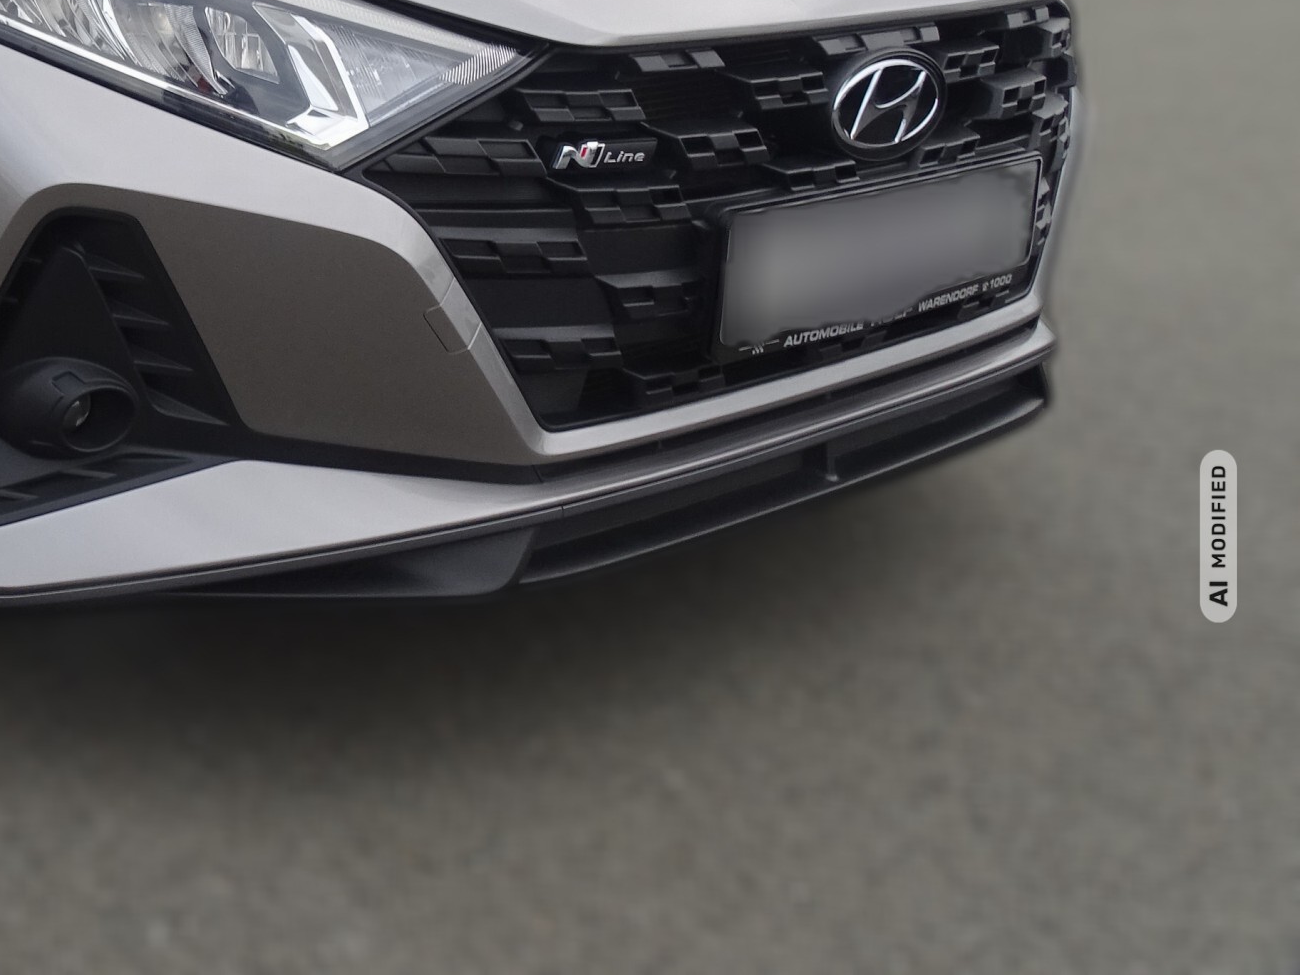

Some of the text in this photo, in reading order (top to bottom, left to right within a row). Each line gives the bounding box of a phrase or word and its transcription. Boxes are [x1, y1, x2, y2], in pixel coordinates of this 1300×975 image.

[603, 151, 646, 164] Line
[783, 322, 864, 347] AUTOMOBILE
[918, 283, 979, 313] WARENDORF
